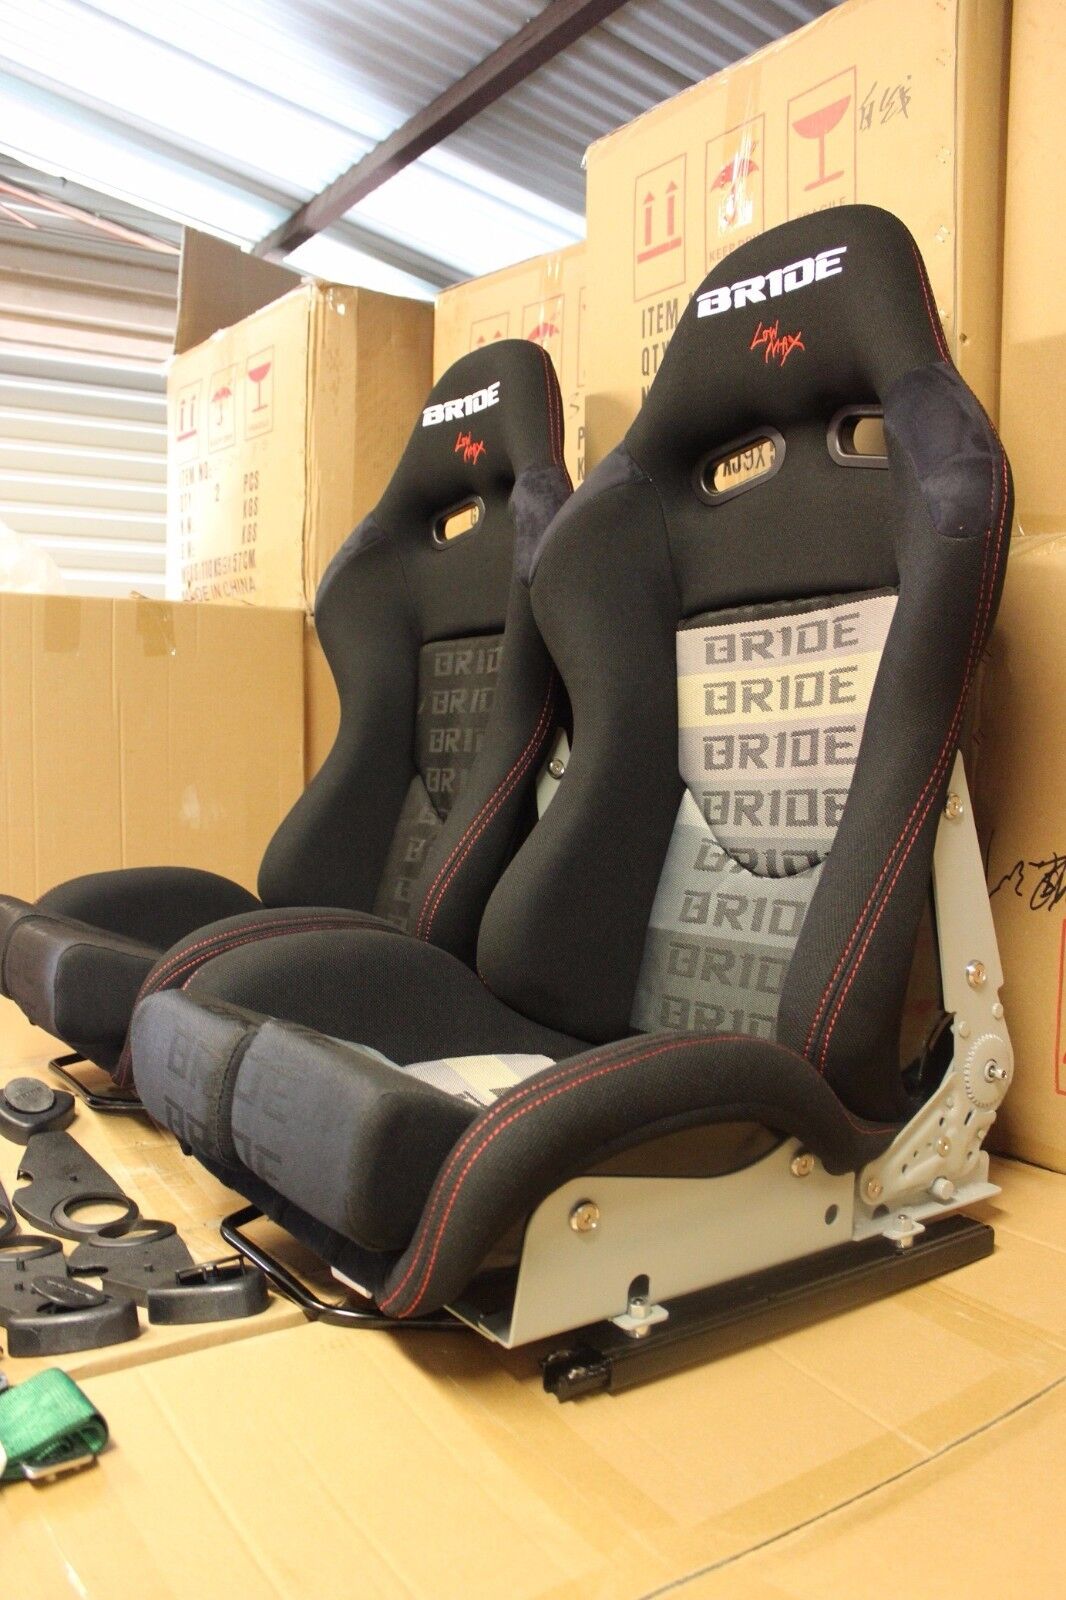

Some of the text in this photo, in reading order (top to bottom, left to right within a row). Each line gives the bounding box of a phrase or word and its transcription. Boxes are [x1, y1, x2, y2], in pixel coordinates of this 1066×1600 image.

[641, 298, 679, 339] ITEM
[222, 575, 257, 598] CHINA
[433, 646, 504, 678] BRID
[678, 889, 807, 937] BRID
[666, 940, 790, 994] BRID
